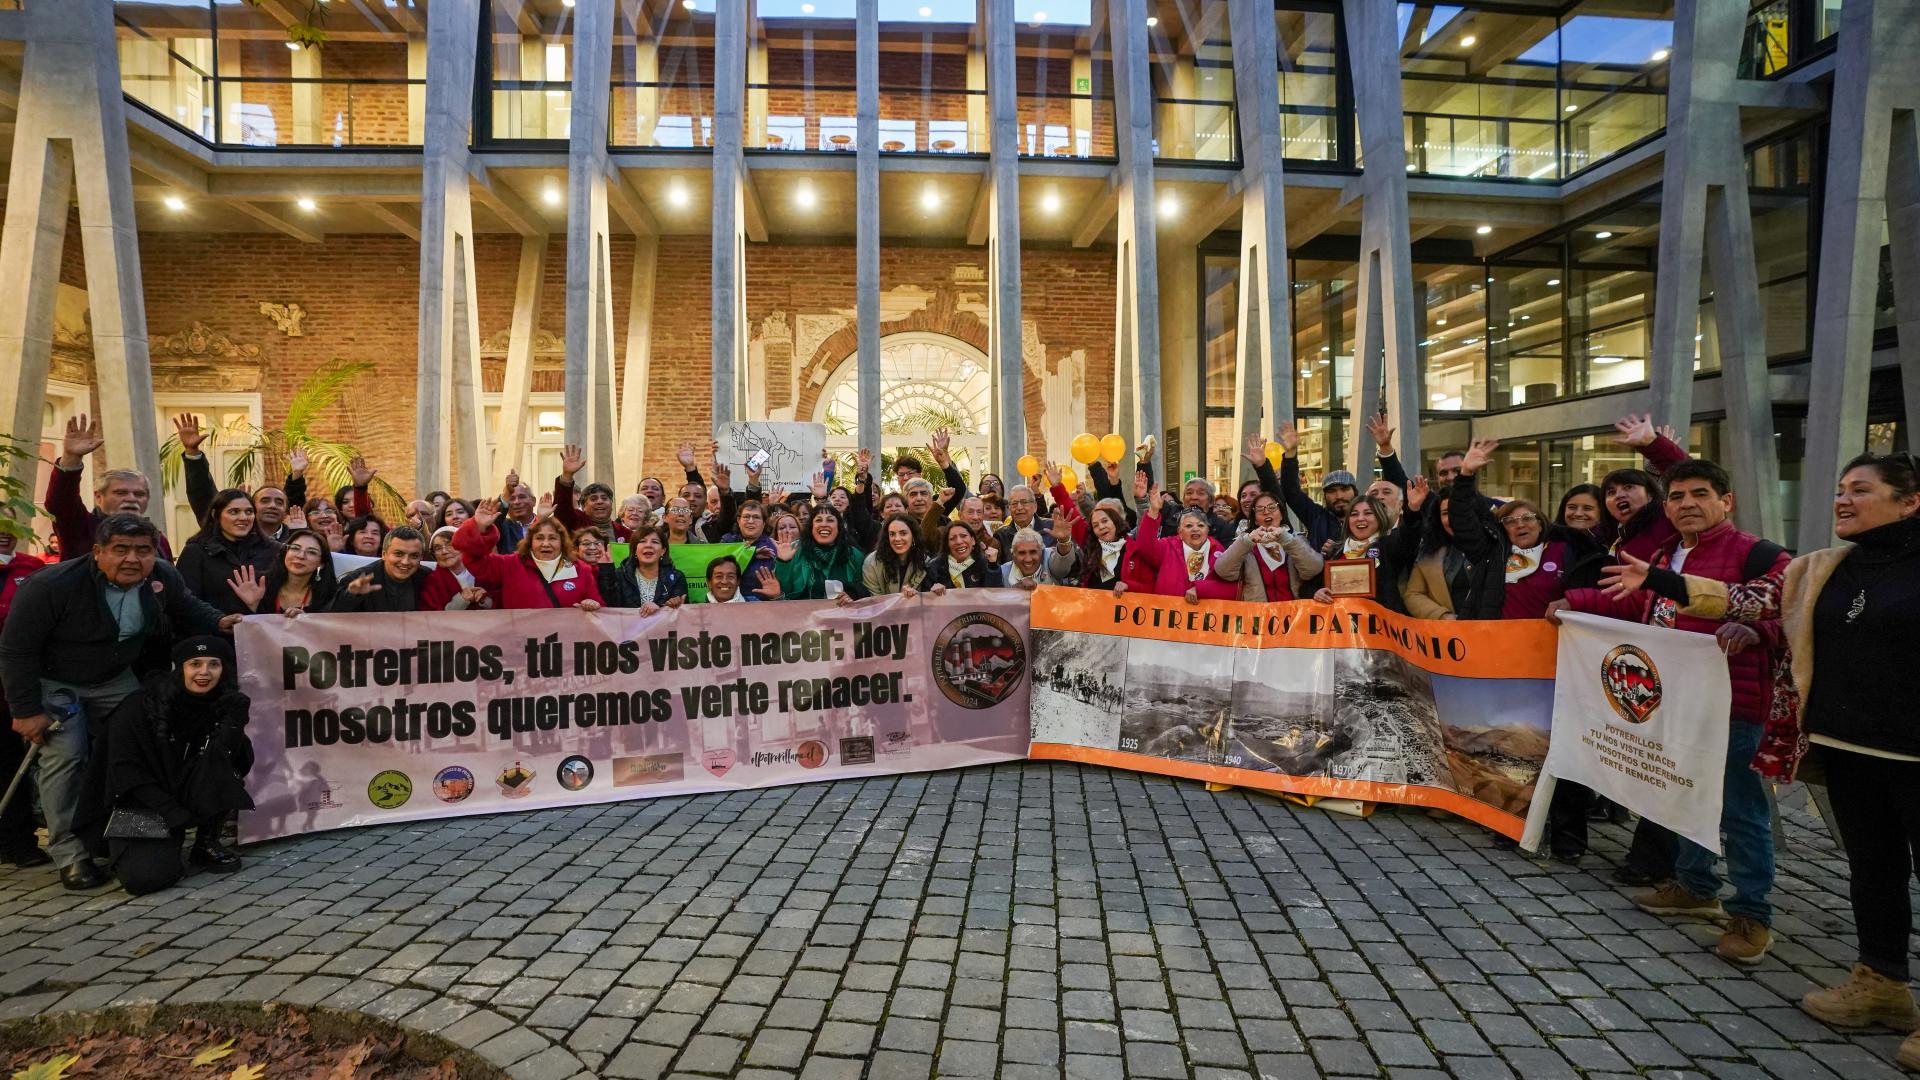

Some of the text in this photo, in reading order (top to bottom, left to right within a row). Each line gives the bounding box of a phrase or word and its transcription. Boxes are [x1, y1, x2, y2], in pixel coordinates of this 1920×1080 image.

[1114, 605, 1466, 662] POTRERILLOS PATRIMONIO
[283, 640, 515, 690] Potrerillos,
[525, 632, 563, 678] tú
[574, 640, 640, 676] nos
[648, 630, 732, 672] viste
[740, 628, 845, 667] nacer;
[853, 622, 909, 660] Hoy
[285, 671, 913, 748] nosotros queremos verte renacer.
[1121, 737, 1138, 749] 1925
[1590, 729, 1676, 770] TU NOS VISTE NACER
[1605, 723, 1663, 751] POTRERILLOS
[1224, 755, 1241, 765] 1940
[1334, 764, 1352, 775] 1970
[1596, 743, 1638, 767] NOSOTROS
[1641, 762, 1694, 788] QUEREMOS
[1599, 755, 1667, 790] VERTE RENACER
